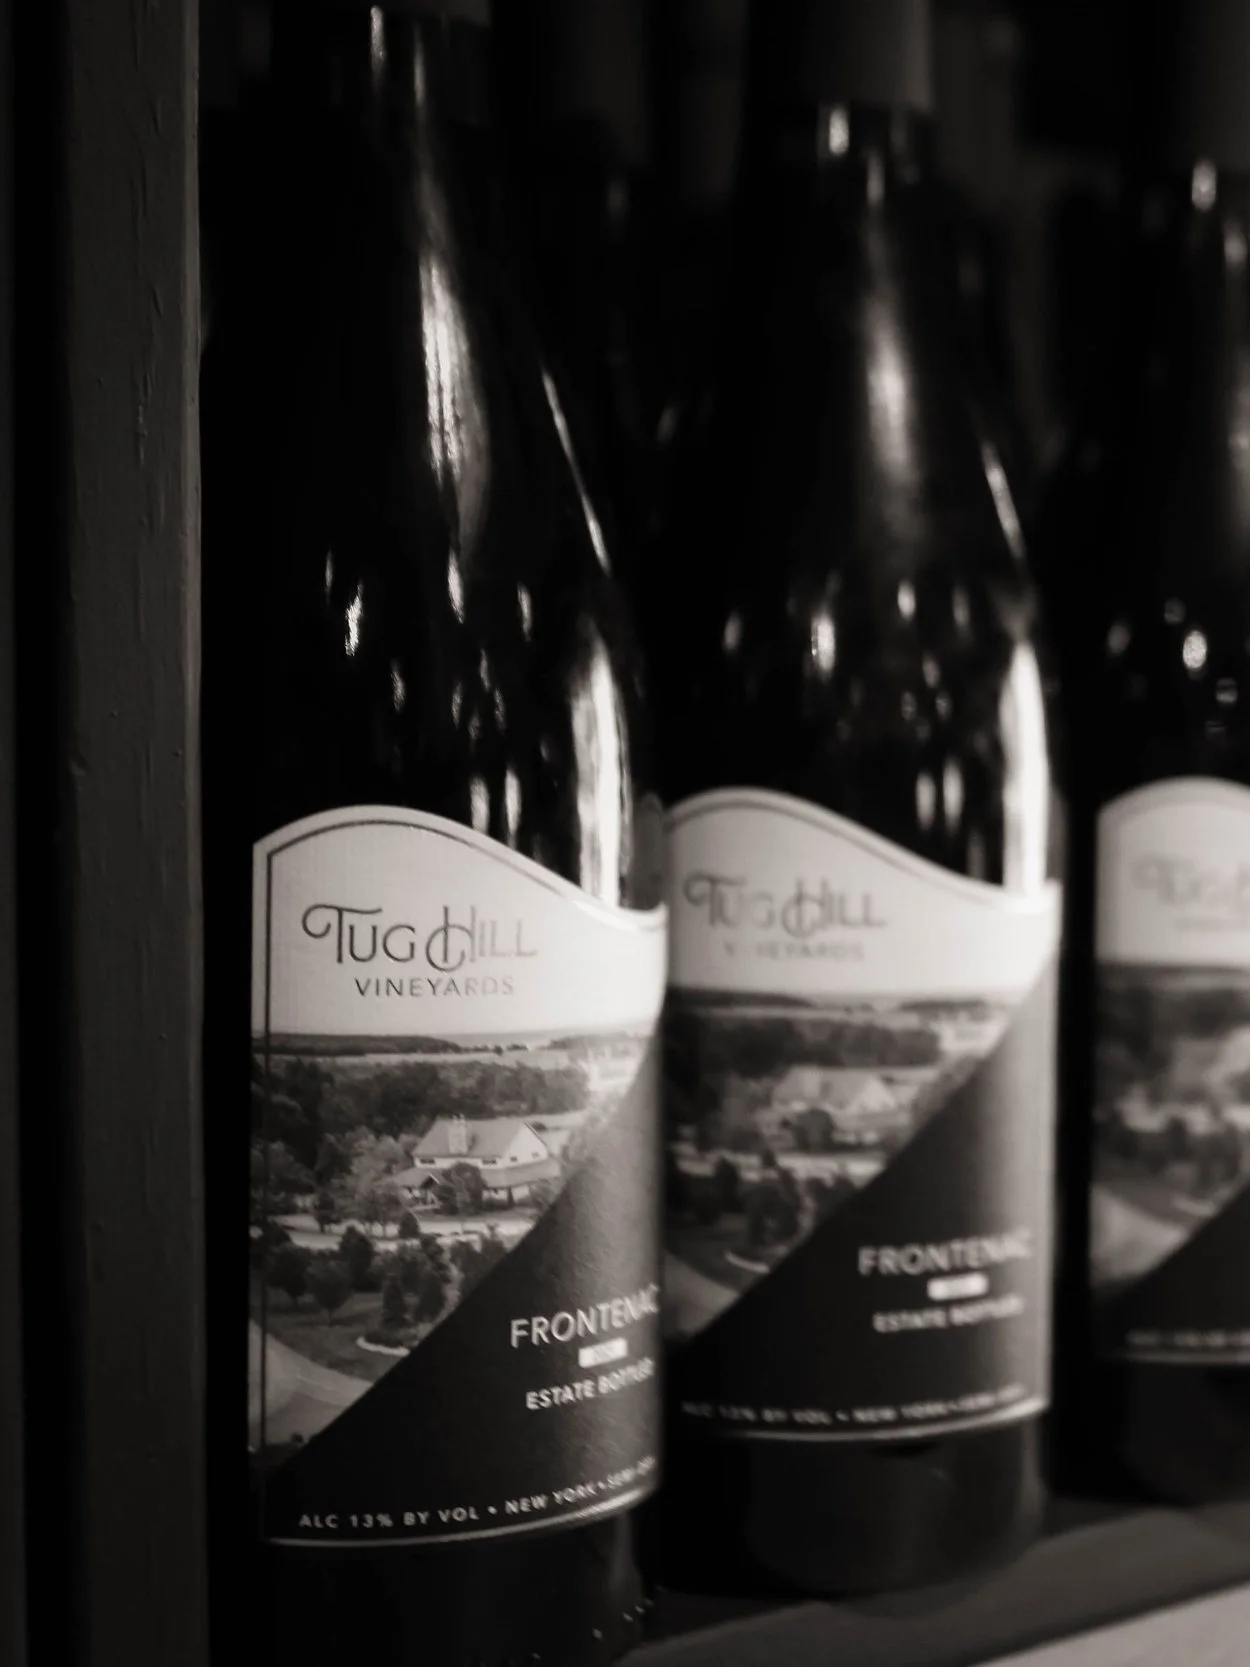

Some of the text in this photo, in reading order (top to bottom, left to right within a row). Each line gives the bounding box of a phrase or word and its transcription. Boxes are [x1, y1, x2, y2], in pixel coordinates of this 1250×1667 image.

[682, 870, 888, 938] TUG HILL
[302, 903, 538, 973] TUG HILL
[722, 939, 865, 960] VNEYARDS
[354, 976, 514, 997] VINEYARDS
[872, 1308, 947, 1333] ESTATE
[525, 1379, 597, 1411] ESTATE
[299, 1513, 338, 1529] ALC
[350, 1512, 394, 1529] 13%
[403, 1511, 430, 1526] BY
[437, 1505, 480, 1523] VOL
[504, 1493, 549, 1515] NEW
[551, 1482, 597, 1506] YORK
